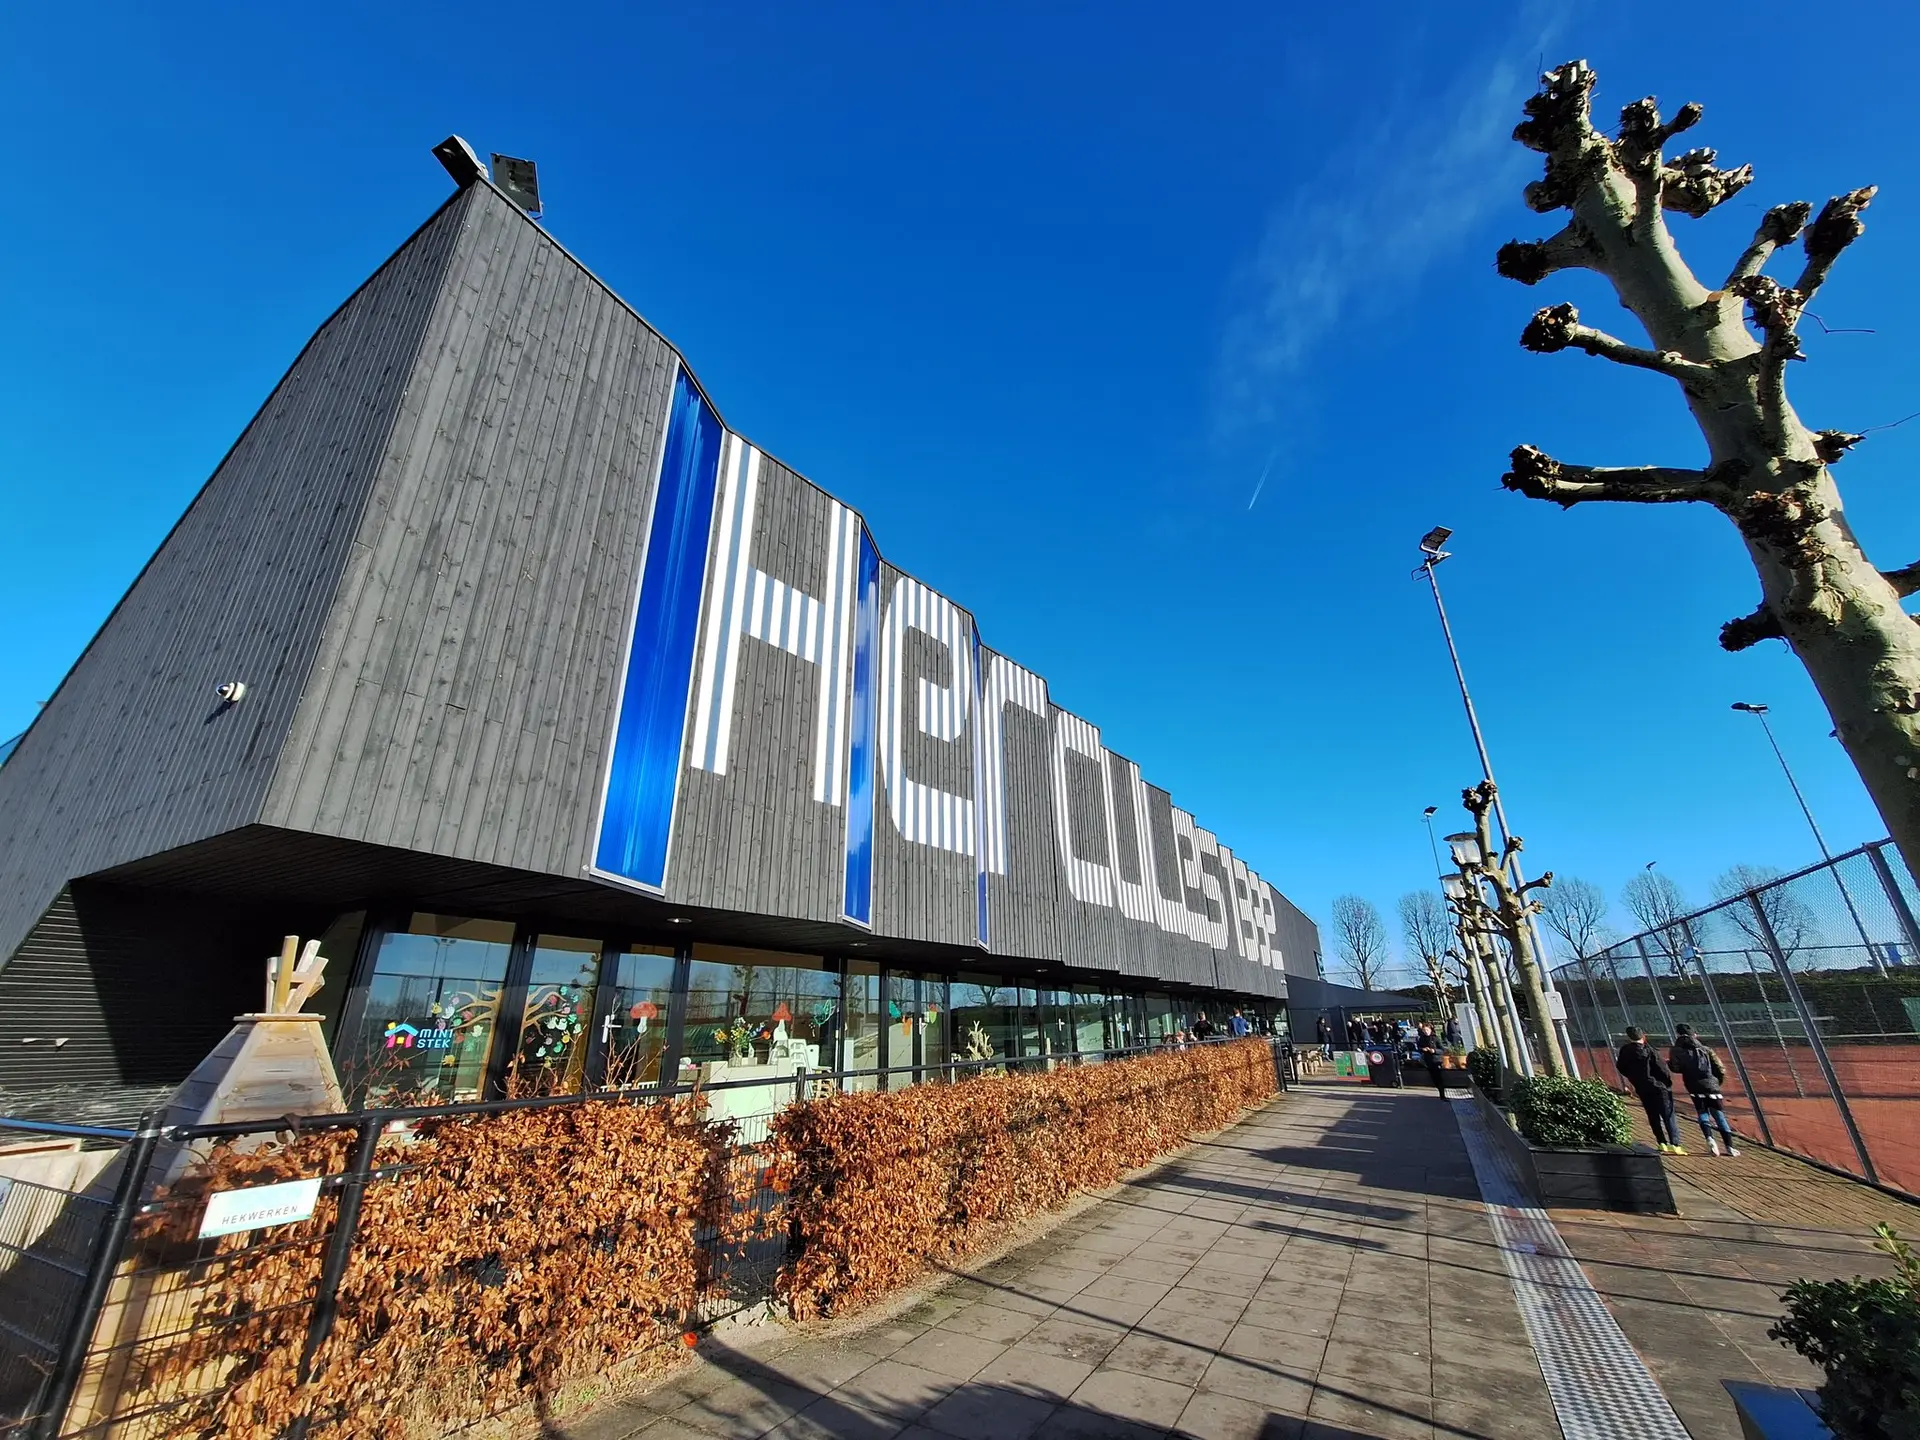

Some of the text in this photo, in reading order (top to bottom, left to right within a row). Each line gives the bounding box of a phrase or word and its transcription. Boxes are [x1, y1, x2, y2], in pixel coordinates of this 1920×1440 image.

[421, 1029, 453, 1038] MINI
[418, 1040, 450, 1048] STEK
[222, 1206, 297, 1224] HEKWERKEN
